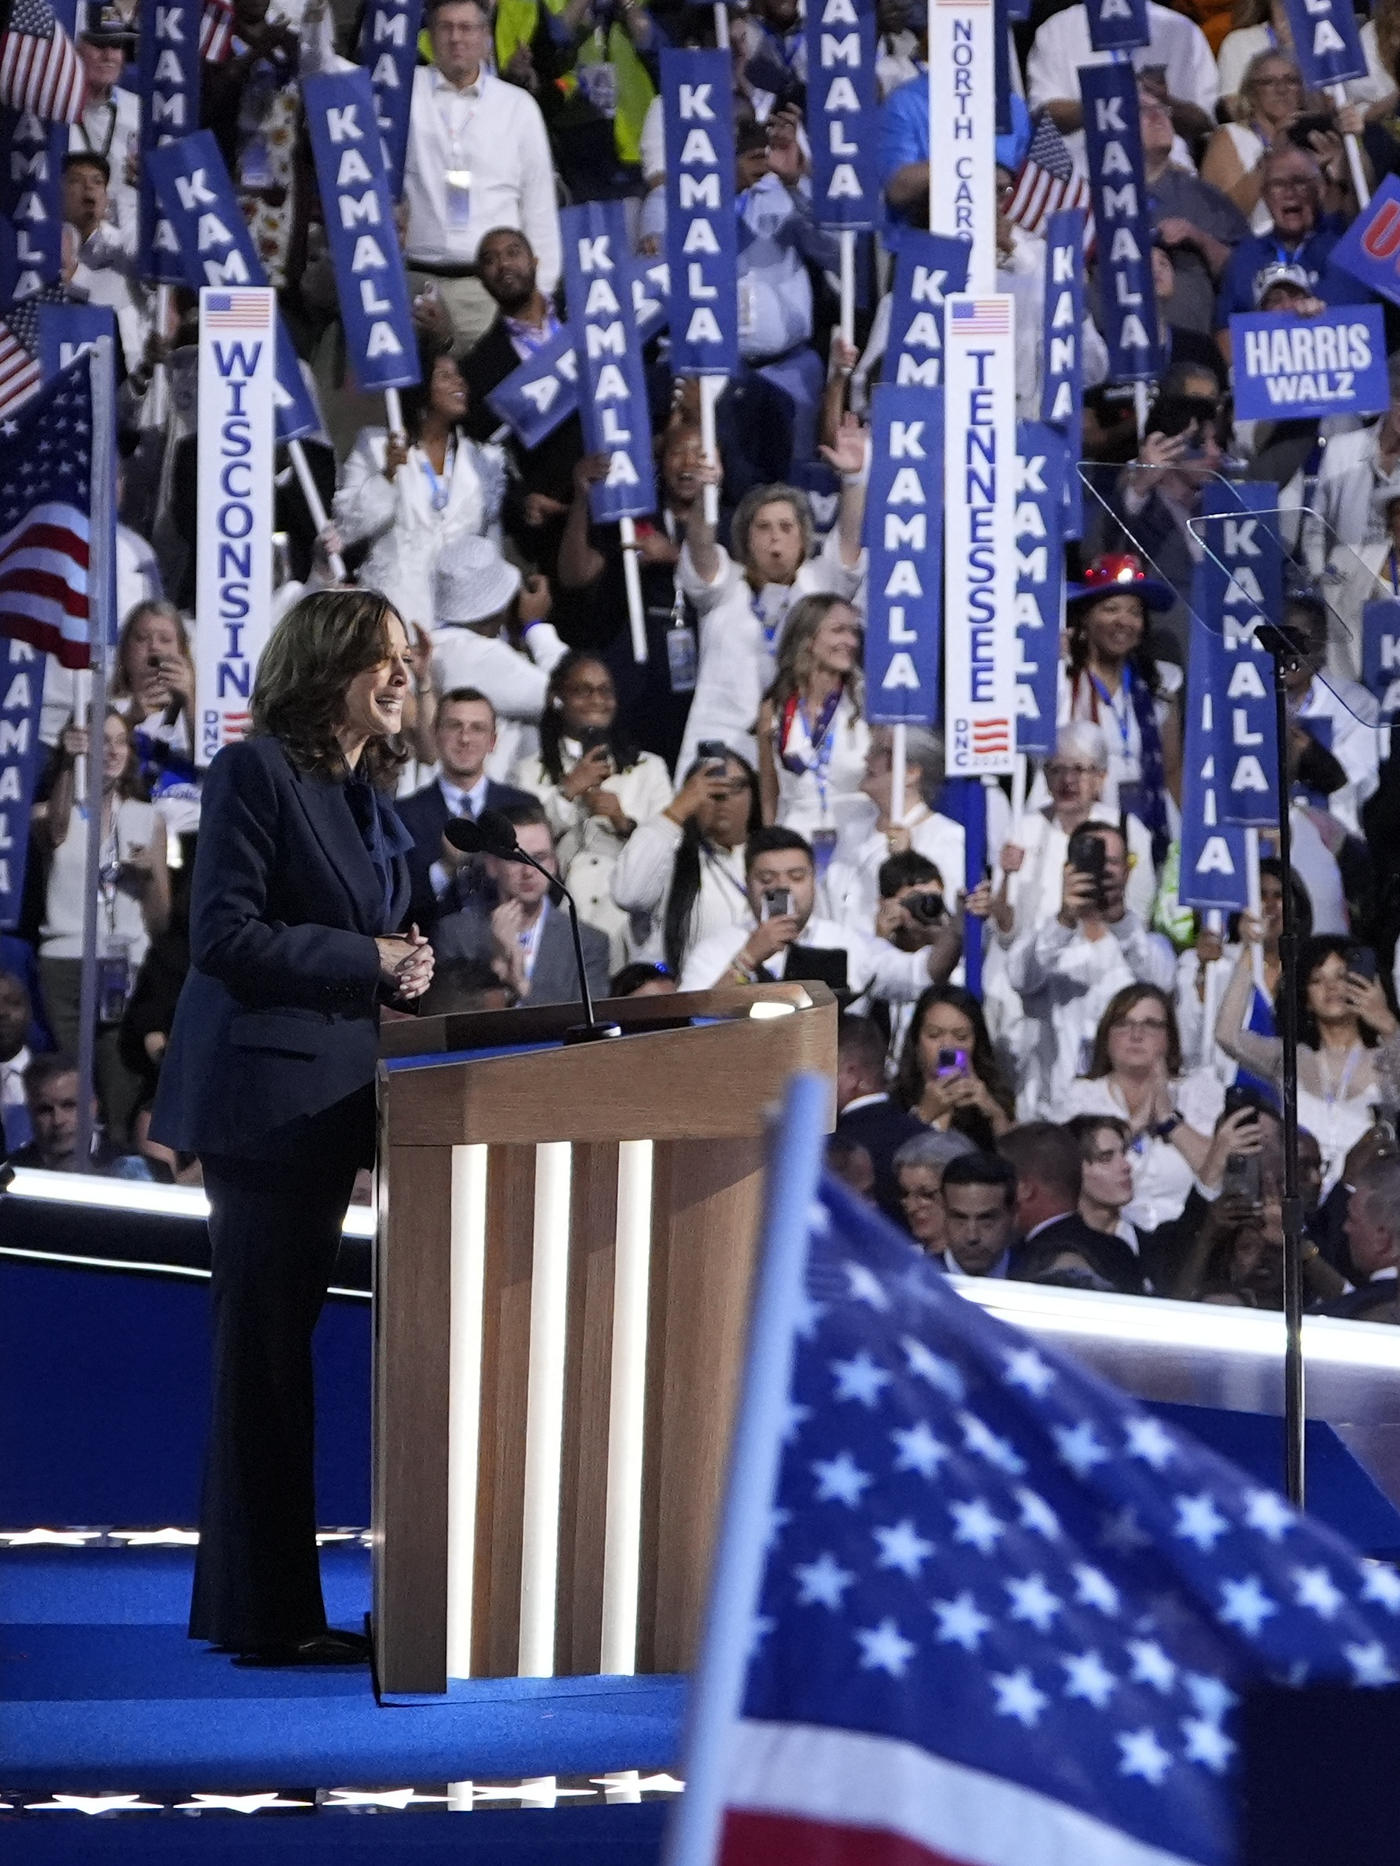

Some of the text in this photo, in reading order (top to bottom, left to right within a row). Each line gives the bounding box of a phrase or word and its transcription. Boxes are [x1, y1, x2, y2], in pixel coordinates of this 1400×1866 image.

[11, 112, 48, 300] AMALA
[152, 6, 188, 251] KAMA
[953, 19, 973, 140] NORTH
[326, 104, 403, 359] KAMALA
[679, 83, 723, 343] KAMALA
[1096, 97, 1150, 350] KAMALA
[578, 235, 640, 489] KAMALA
[1244, 323, 1372, 378] HARRIS
[1266, 371, 1356, 404] WALZ
[212, 341, 263, 698] WISCONSIN
[882, 421, 927, 689] KAMALA
[966, 350, 996, 702] TENNESSEE
[205, 710, 219, 758] DNC
[954, 718, 968, 767] DNC
[1222, 518, 1270, 794] KAMALA
